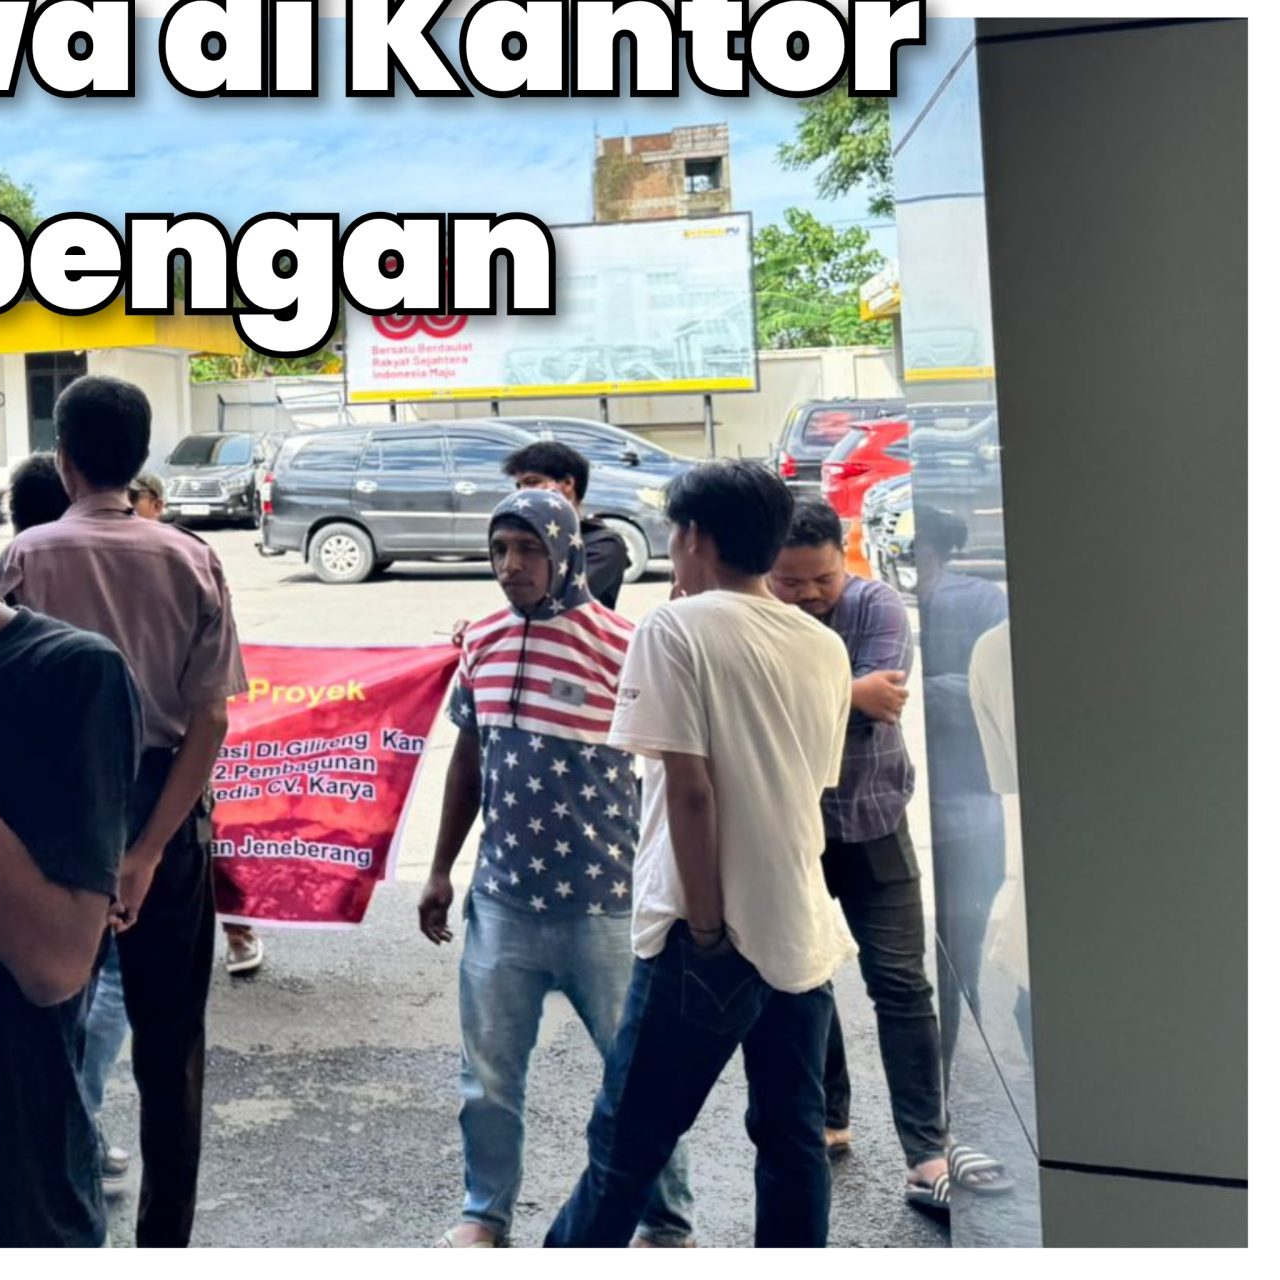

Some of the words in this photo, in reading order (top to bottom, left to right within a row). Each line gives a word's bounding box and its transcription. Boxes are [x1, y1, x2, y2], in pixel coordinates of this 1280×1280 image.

[371, 344, 415, 355] Bersatu
[418, 342, 472, 354] Berdaulat
[371, 357, 410, 368] Rakyat
[412, 355, 468, 367] Sejahtera
[429, 368, 456, 380] Maju
[247, 677, 366, 708] Proyek
[213, 784, 261, 801] edia
[309, 776, 375, 801] Karya
[239, 836, 371, 867] Jeneberang
